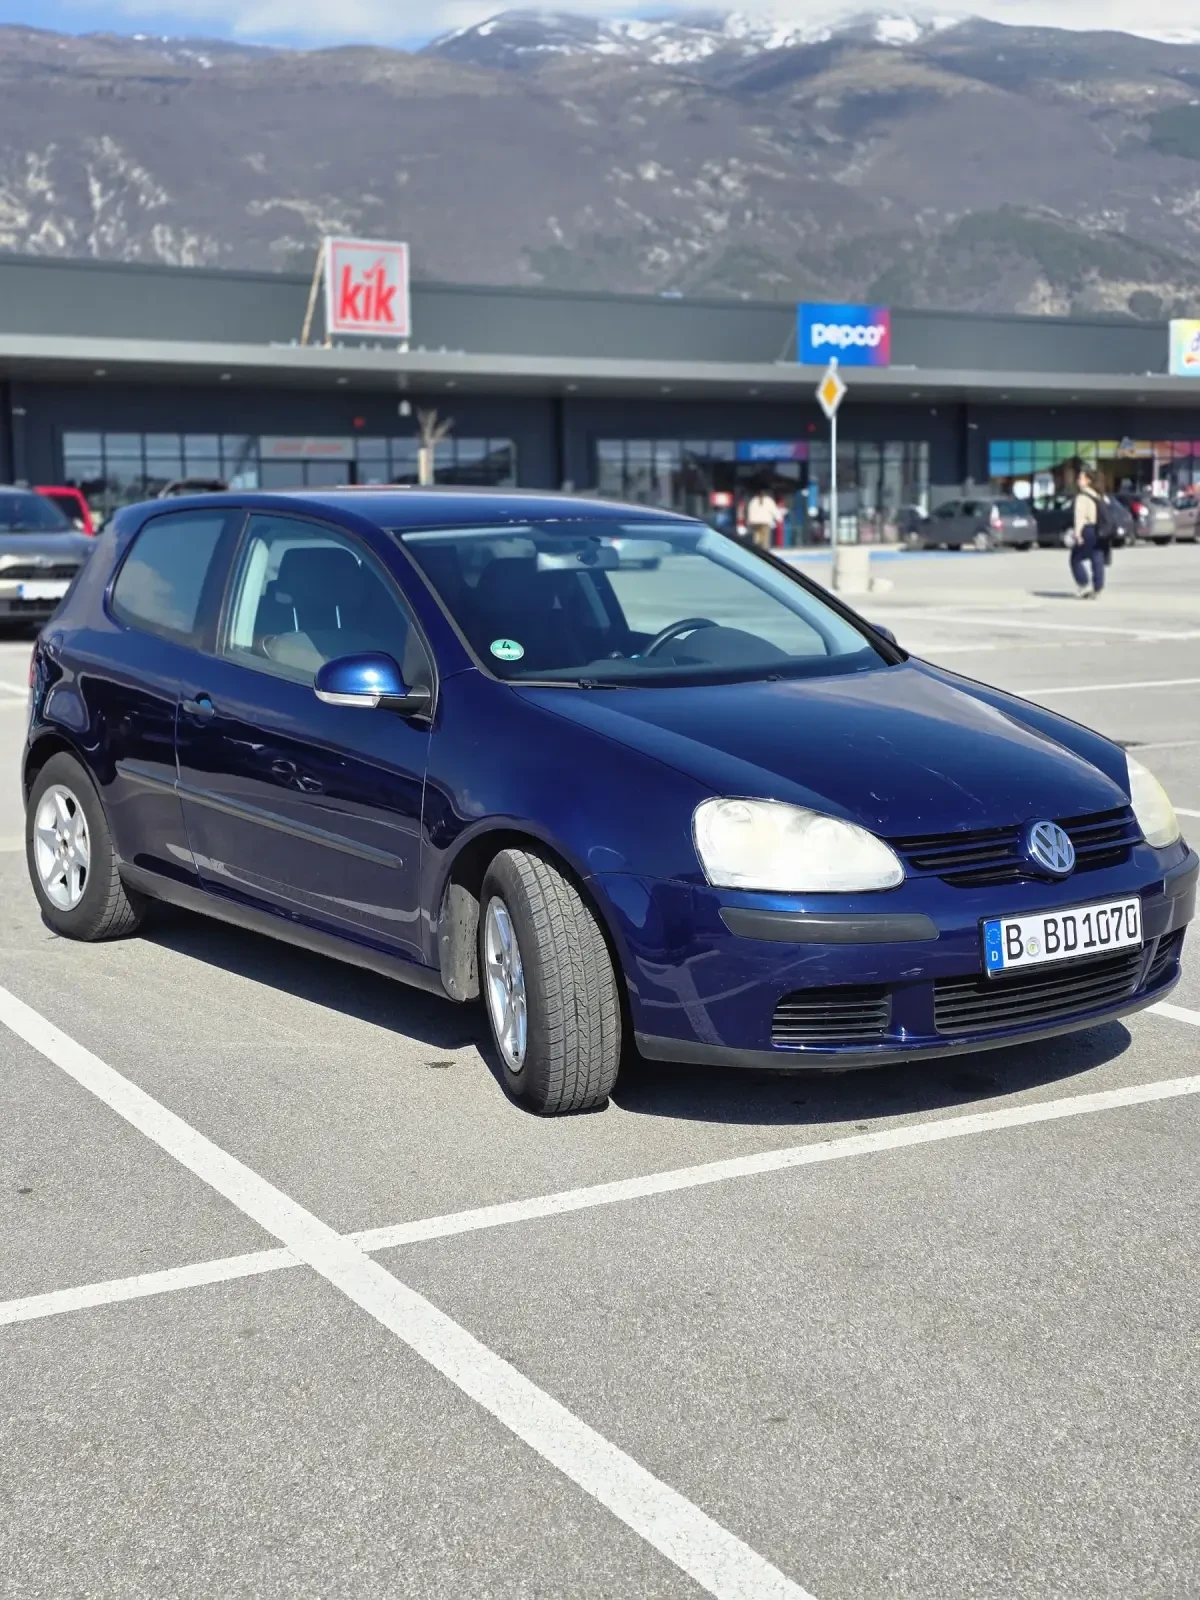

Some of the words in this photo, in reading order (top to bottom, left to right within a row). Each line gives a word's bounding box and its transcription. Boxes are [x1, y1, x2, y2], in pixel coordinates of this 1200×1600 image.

[811, 323, 881, 349] pepco
[502, 641, 511, 650] 4
[991, 950, 999, 962] D
